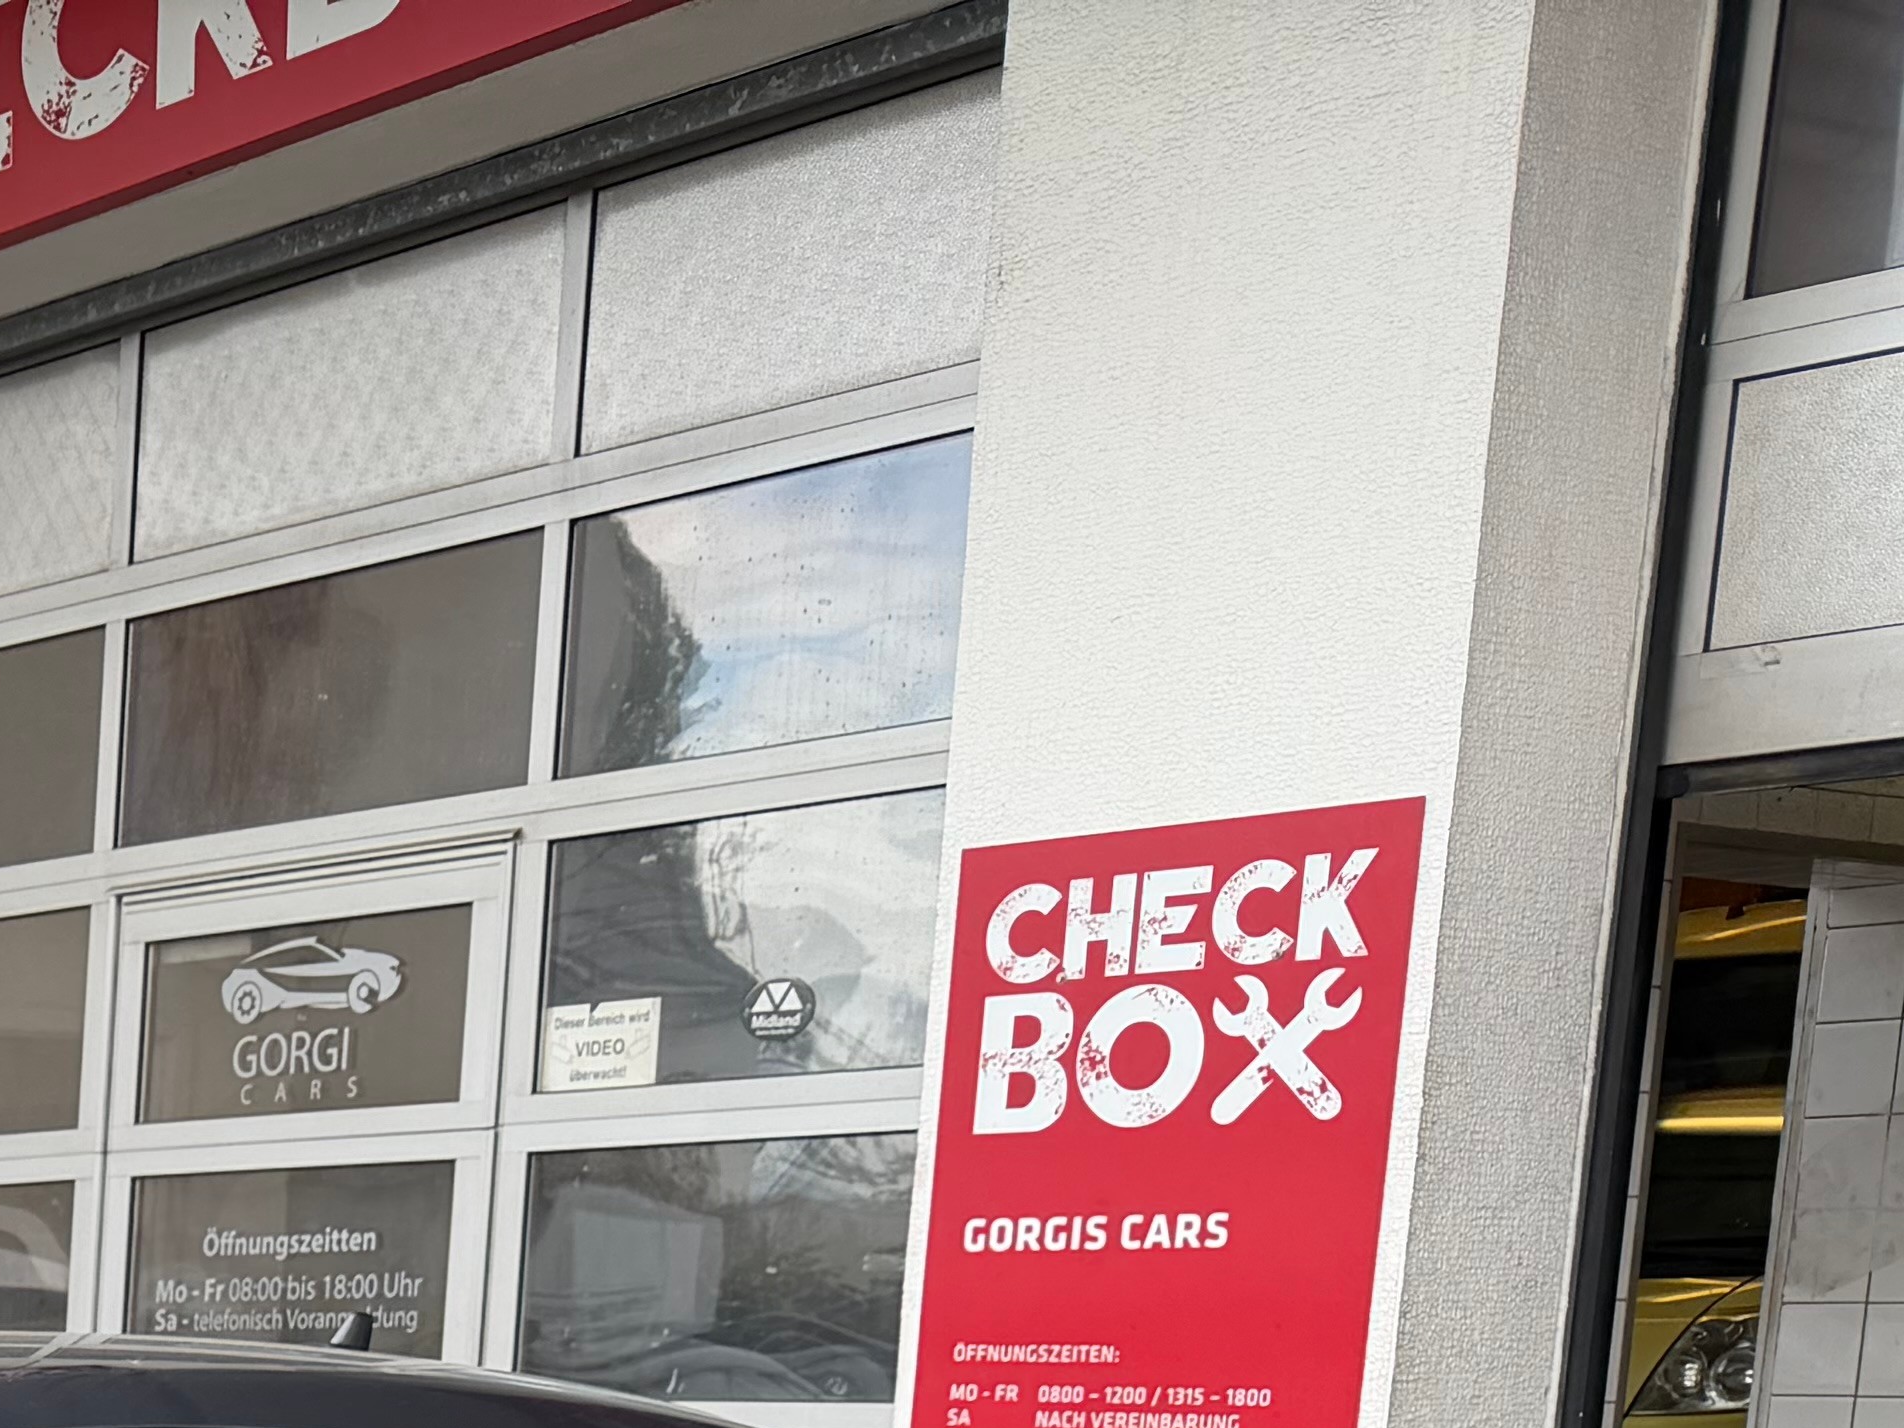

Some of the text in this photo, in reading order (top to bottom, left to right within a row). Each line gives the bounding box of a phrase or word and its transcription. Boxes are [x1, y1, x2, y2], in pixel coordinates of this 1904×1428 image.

[985, 847, 1380, 984] CHECK
[554, 1017, 586, 1031] Dieser
[628, 1009, 650, 1024] wird
[750, 1012, 801, 1029] Midland
[232, 1026, 350, 1079] GORGI
[575, 1037, 625, 1058] VIDEO
[240, 1075, 358, 1105] CARS
[202, 1226, 376, 1261] Öffnungszeitten
[963, 1211, 1230, 1254] GORGIS CARS
[155, 1280, 187, 1304] Mo
[203, 1278, 225, 1302] Fr
[228, 1276, 284, 1302] 08:00
[286, 1274, 316, 1301] bis
[322, 1272, 377, 1299] 18:00
[382, 1270, 423, 1298] Uhr
[154, 1308, 177, 1332] Sa
[193, 1306, 283, 1332] telefonisch
[953, 1342, 1120, 1363] ÖFFNUNGSZEITEN:
[949, 1384, 978, 1401] MO
[994, 1384, 1019, 1402] FR
[1038, 1385, 1084, 1404] 0800
[1104, 1386, 1147, 1405] 1200
[1150, 1386, 1162, 1407] /
[1167, 1387, 1204, 1406] 1315
[1226, 1388, 1272, 1408] 1800
[946, 1408, 972, 1427] SA
